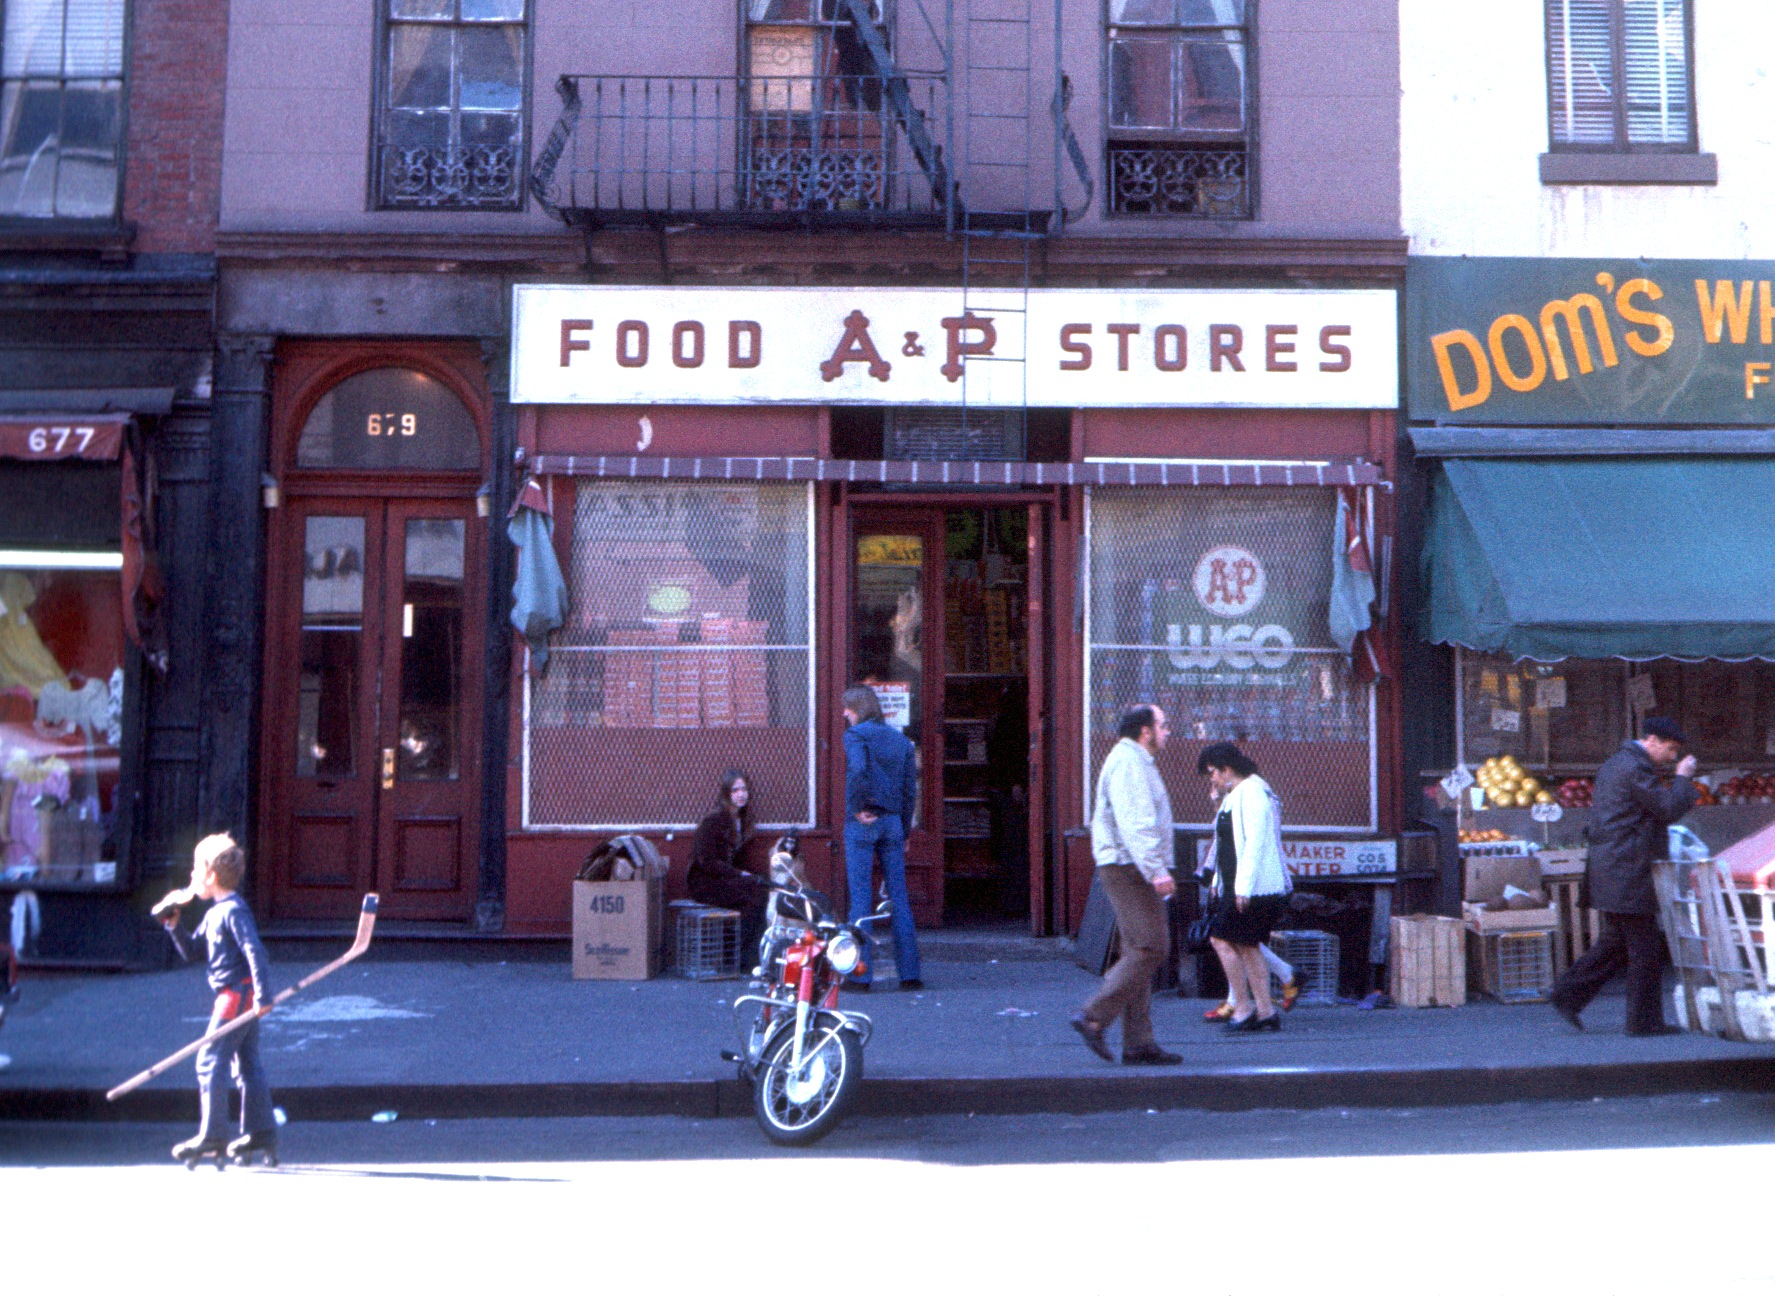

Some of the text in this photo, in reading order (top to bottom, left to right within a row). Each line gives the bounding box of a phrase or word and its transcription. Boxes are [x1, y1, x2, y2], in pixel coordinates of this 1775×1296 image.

[559, 318, 762, 369] FOOD
[1059, 322, 1352, 373] STORES
[1430, 271, 1675, 412] DOM'S
[28, 426, 95, 453] 677
[590, 894, 625, 914] 4150
